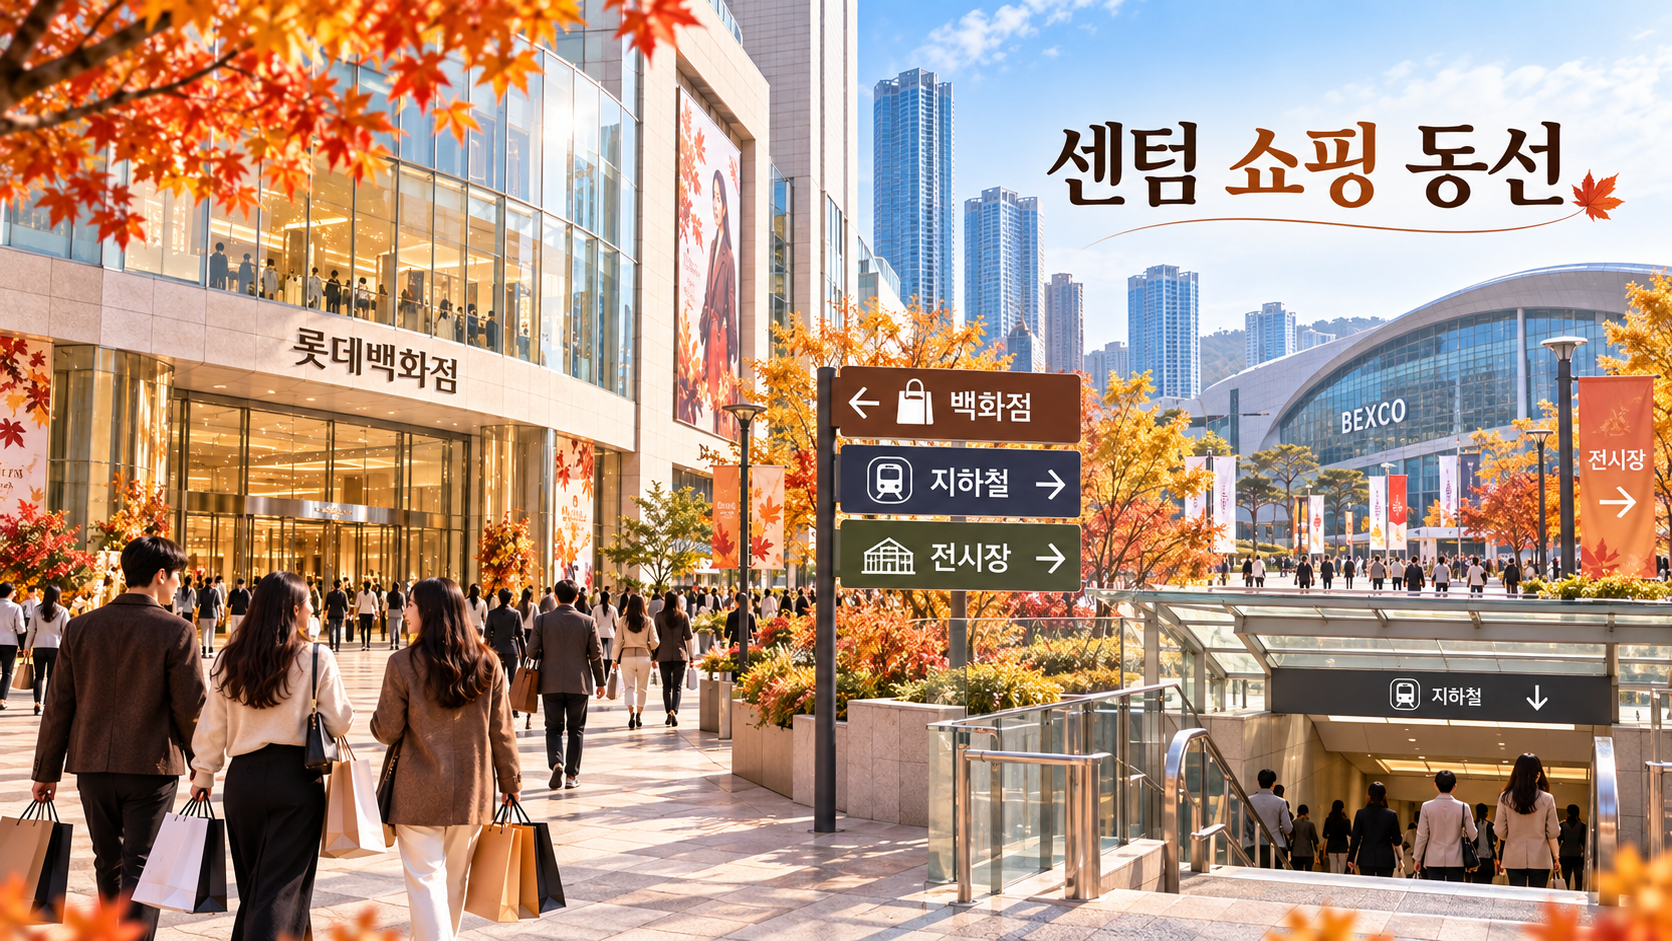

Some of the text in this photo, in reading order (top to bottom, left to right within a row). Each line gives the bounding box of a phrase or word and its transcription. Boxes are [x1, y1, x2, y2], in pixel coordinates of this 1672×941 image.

[293, 327, 458, 394] 롯데백화점
[950, 390, 1031, 422] 백화점
[1341, 398, 1406, 434] BEXCO
[1588, 448, 1647, 471] 전시장
[930, 467, 1009, 498] 지하철
[930, 542, 1011, 573] 전시장
[1431, 686, 1482, 706] 지하철
